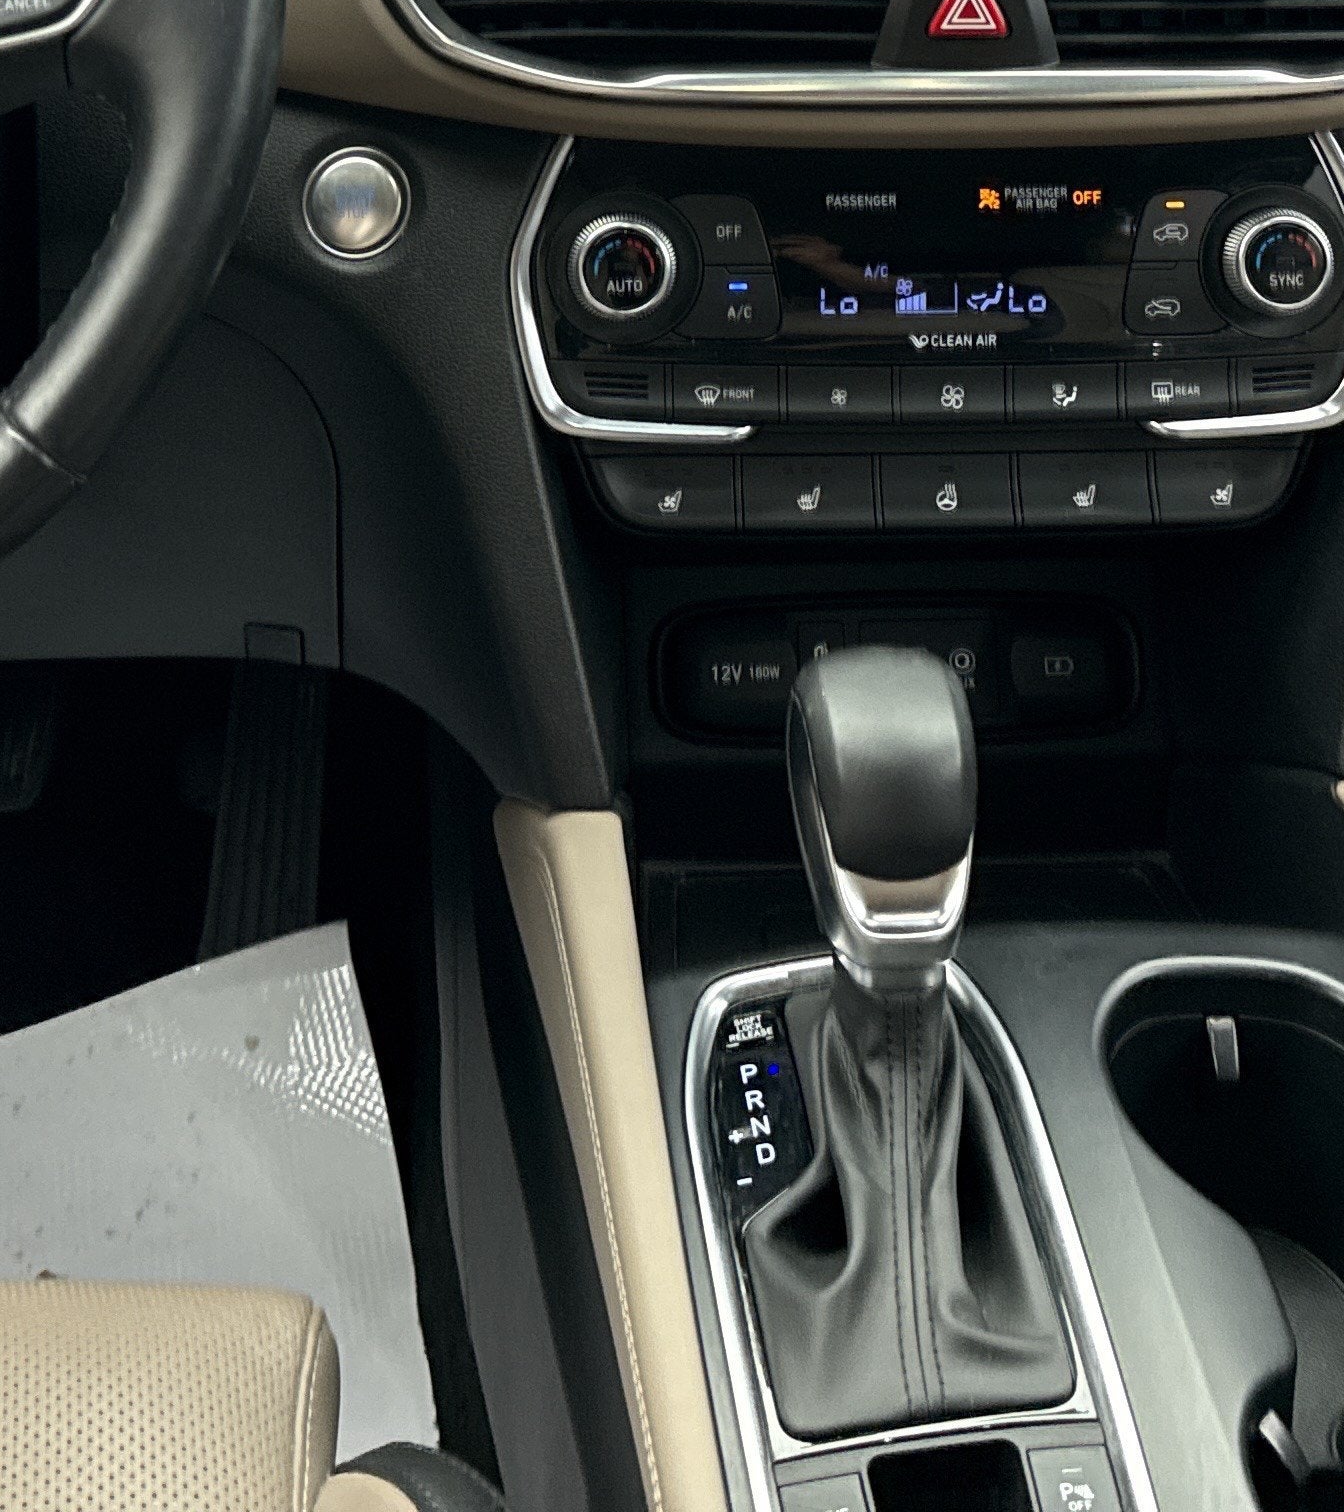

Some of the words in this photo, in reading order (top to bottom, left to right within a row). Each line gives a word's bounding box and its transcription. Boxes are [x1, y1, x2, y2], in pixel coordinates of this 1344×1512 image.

[824, 192, 898, 209] PASSENGER
[1004, 186, 1068, 199] PASSENGER
[1072, 189, 1102, 206] OFF
[1015, 198, 1034, 210] AIR
[1035, 198, 1058, 210] BAG
[715, 224, 743, 240] OFF
[863, 263, 889, 281] A/C
[1268, 272, 1305, 289] SYNC
[606, 279, 643, 295] AUTO
[726, 304, 753, 322] A/C
[930, 333, 973, 348] CLEAN
[975, 333, 998, 348] AIR
[722, 386, 755, 401] FRONT
[1174, 384, 1201, 397] REAR
[711, 662, 743, 684] 12V
[739, 1063, 758, 1085] P
[744, 1089, 765, 1111] R
[749, 1114, 772, 1139] N
[755, 1142, 777, 1166] D
[1068, 1499, 1093, 1512] OFF
